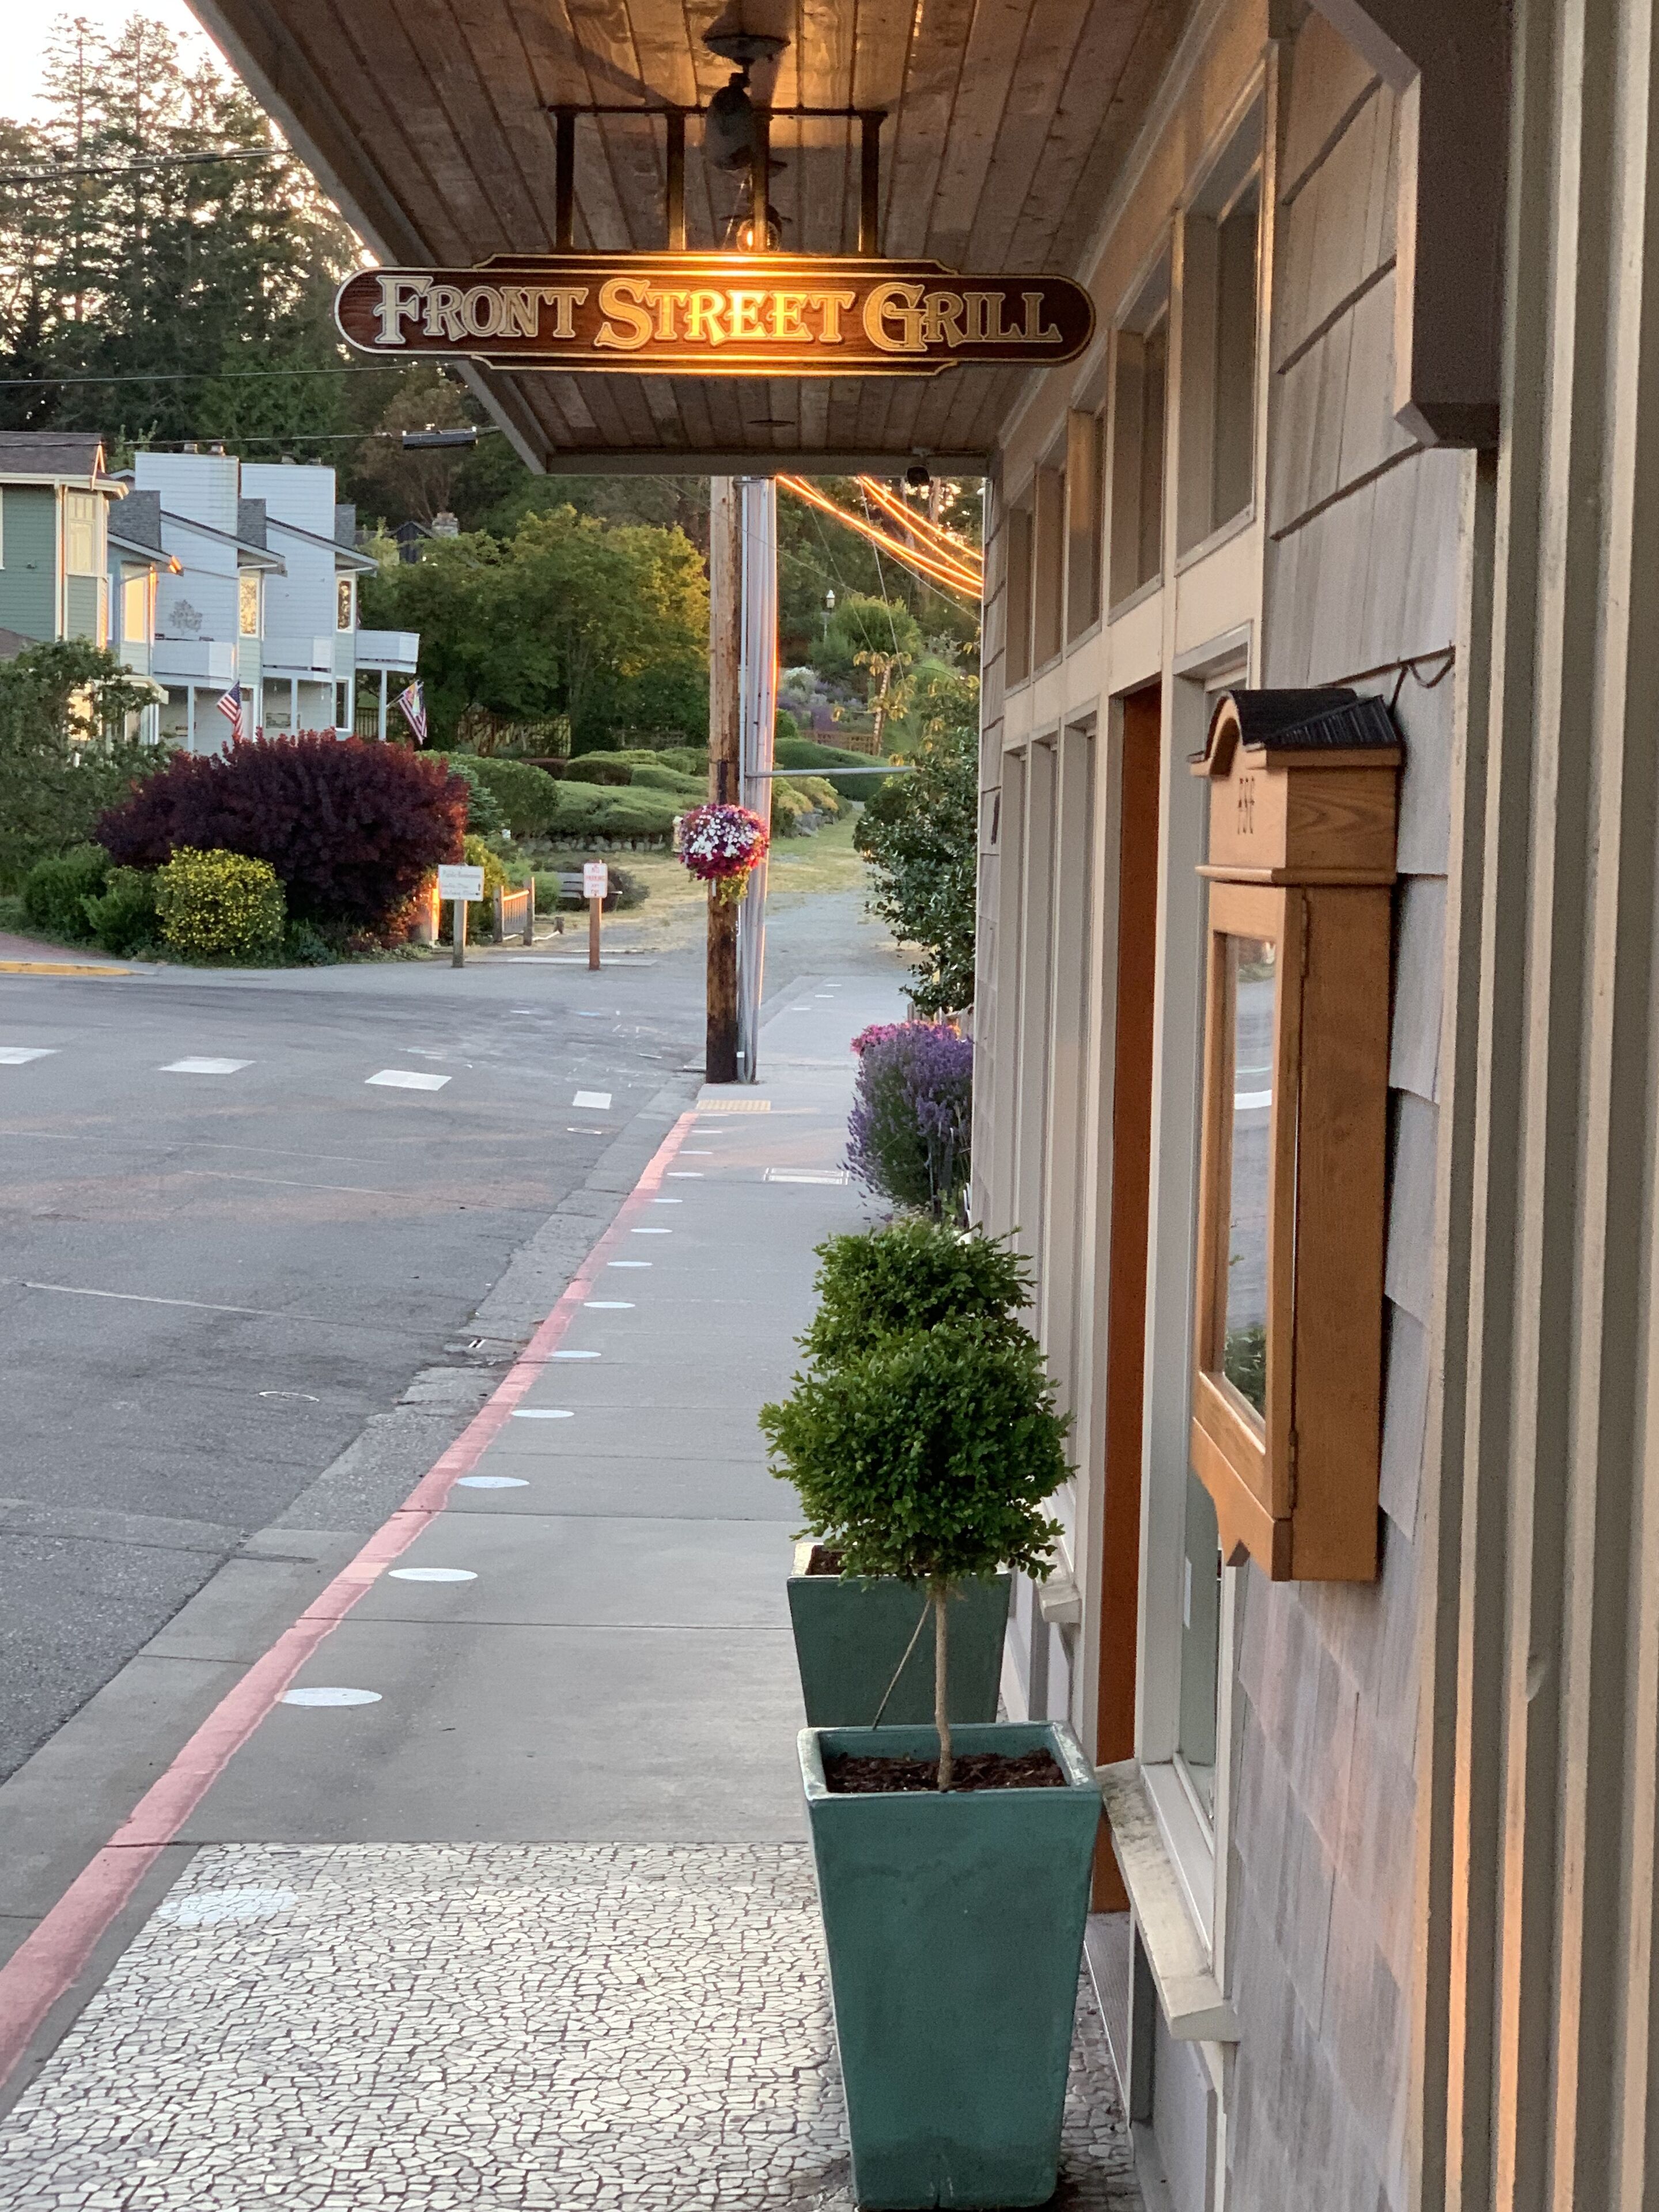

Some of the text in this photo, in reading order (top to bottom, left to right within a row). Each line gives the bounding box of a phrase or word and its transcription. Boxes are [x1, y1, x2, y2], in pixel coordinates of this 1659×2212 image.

[373, 275, 1063, 352] FRONT STREET GRILL
